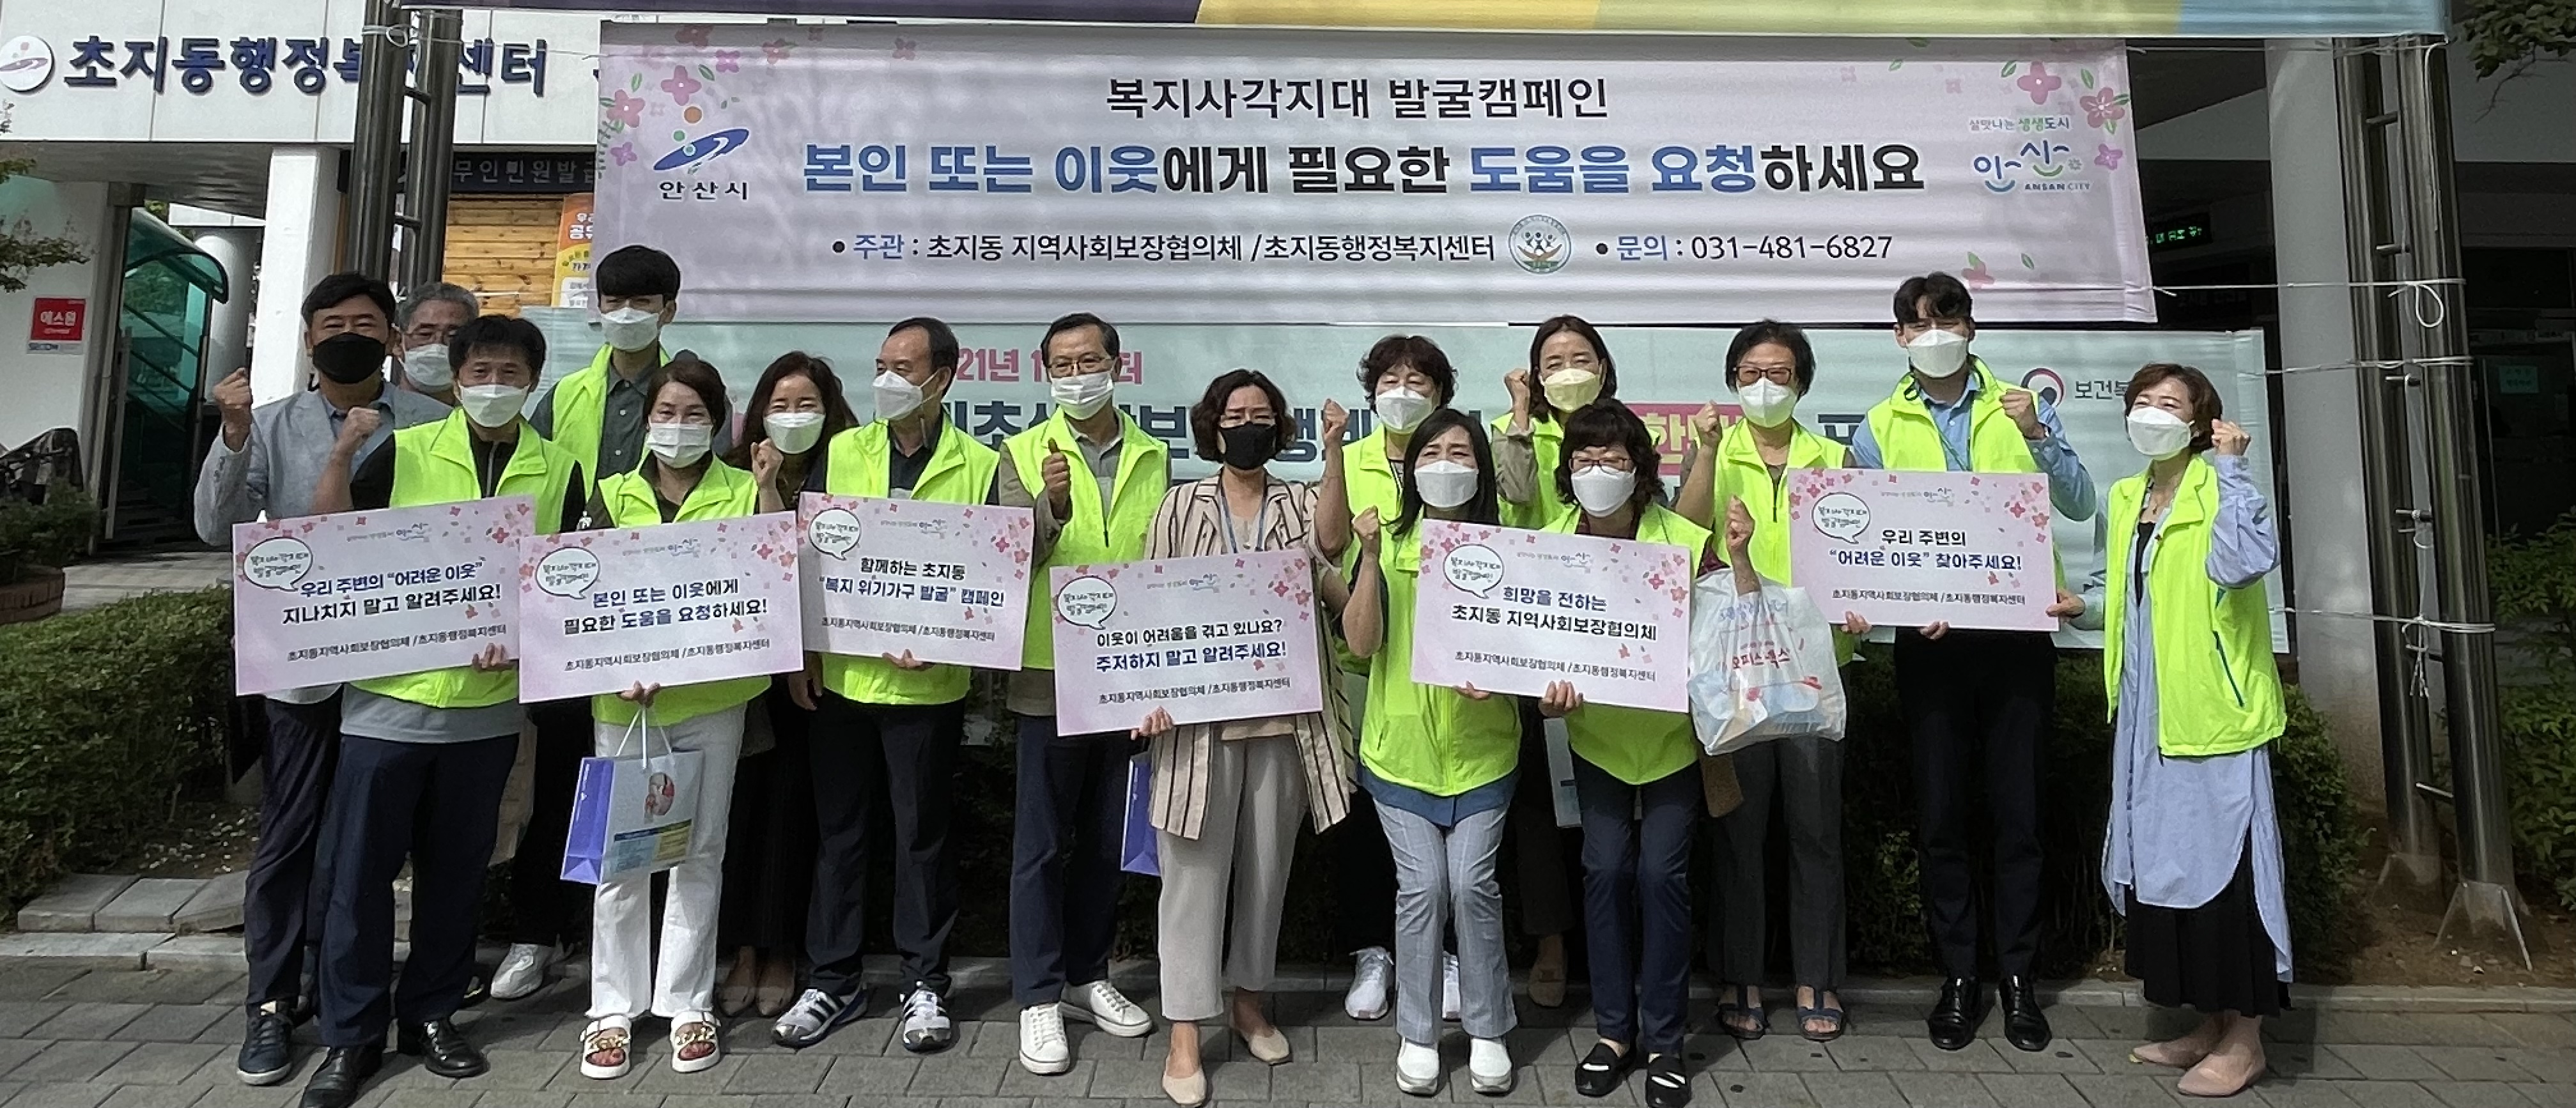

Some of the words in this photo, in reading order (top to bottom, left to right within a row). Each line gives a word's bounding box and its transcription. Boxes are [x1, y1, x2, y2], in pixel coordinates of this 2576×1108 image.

[64, 36, 547, 96] 초지동행정복센터
[1106, 79, 1369, 118] 복지사각지대
[1390, 79, 1608, 119] 발굴캠페인
[1969, 118, 2015, 131] 살맛나는
[2018, 117, 2070, 132] 생생도시
[804, 144, 906, 192] 본인
[929, 144, 1033, 192] 또는
[1055, 146, 1268, 194] 이웃에게
[1289, 146, 1449, 194] 필요한
[1470, 146, 1629, 193] 도움을
[1652, 144, 1925, 192] 요청하세요
[660, 180, 748, 201] 안산시
[853, 234, 905, 261] 주관
[927, 234, 1005, 261] 초지동
[1012, 234, 1242, 261] 지역사회보장협의체
[1616, 235, 1670, 261] 문의
[1691, 235, 1893, 259] 031-481-6827
[958, 348, 1020, 383] 21년
[2075, 380, 2129, 399] 보건복
[1882, 529, 1913, 545] 우리
[1919, 529, 1967, 546] 주변의
[860, 558, 917, 578] 함께하는
[922, 562, 966, 580] 초지동
[1936, 553, 2022, 570] 찾아주세요!
[300, 580, 332, 597] 우리
[336, 573, 384, 593] 주변의
[593, 590, 626, 608] 본인
[632, 587, 665, 604] 또는
[672, 578, 738, 599] 이웃에게
[858, 580, 915, 599] 위기가구
[961, 588, 1004, 607] 캠페인
[283, 602, 356, 624] 지나치지
[363, 597, 399, 616] 말고
[405, 583, 501, 610] 알려주세요!
[1503, 586, 1552, 606] 희망을
[1558, 591, 1608, 612] 전하는
[563, 614, 616, 635] 필요한
[621, 608, 672, 629] 도움을
[678, 598, 768, 623] 요청하세요!
[1451, 604, 1501, 625] 초지동
[1507, 610, 1657, 641] 지역사회보장협의체
[1097, 629, 1138, 647] 이웃이
[1143, 626, 1197, 644] 어려움을
[1202, 624, 1229, 639] 겪고
[1233, 619, 1282, 636] 있나요?
[1096, 651, 1160, 672] 주저하지
[1166, 649, 1197, 666] 말고
[1202, 642, 1286, 664] 알려주세요!
